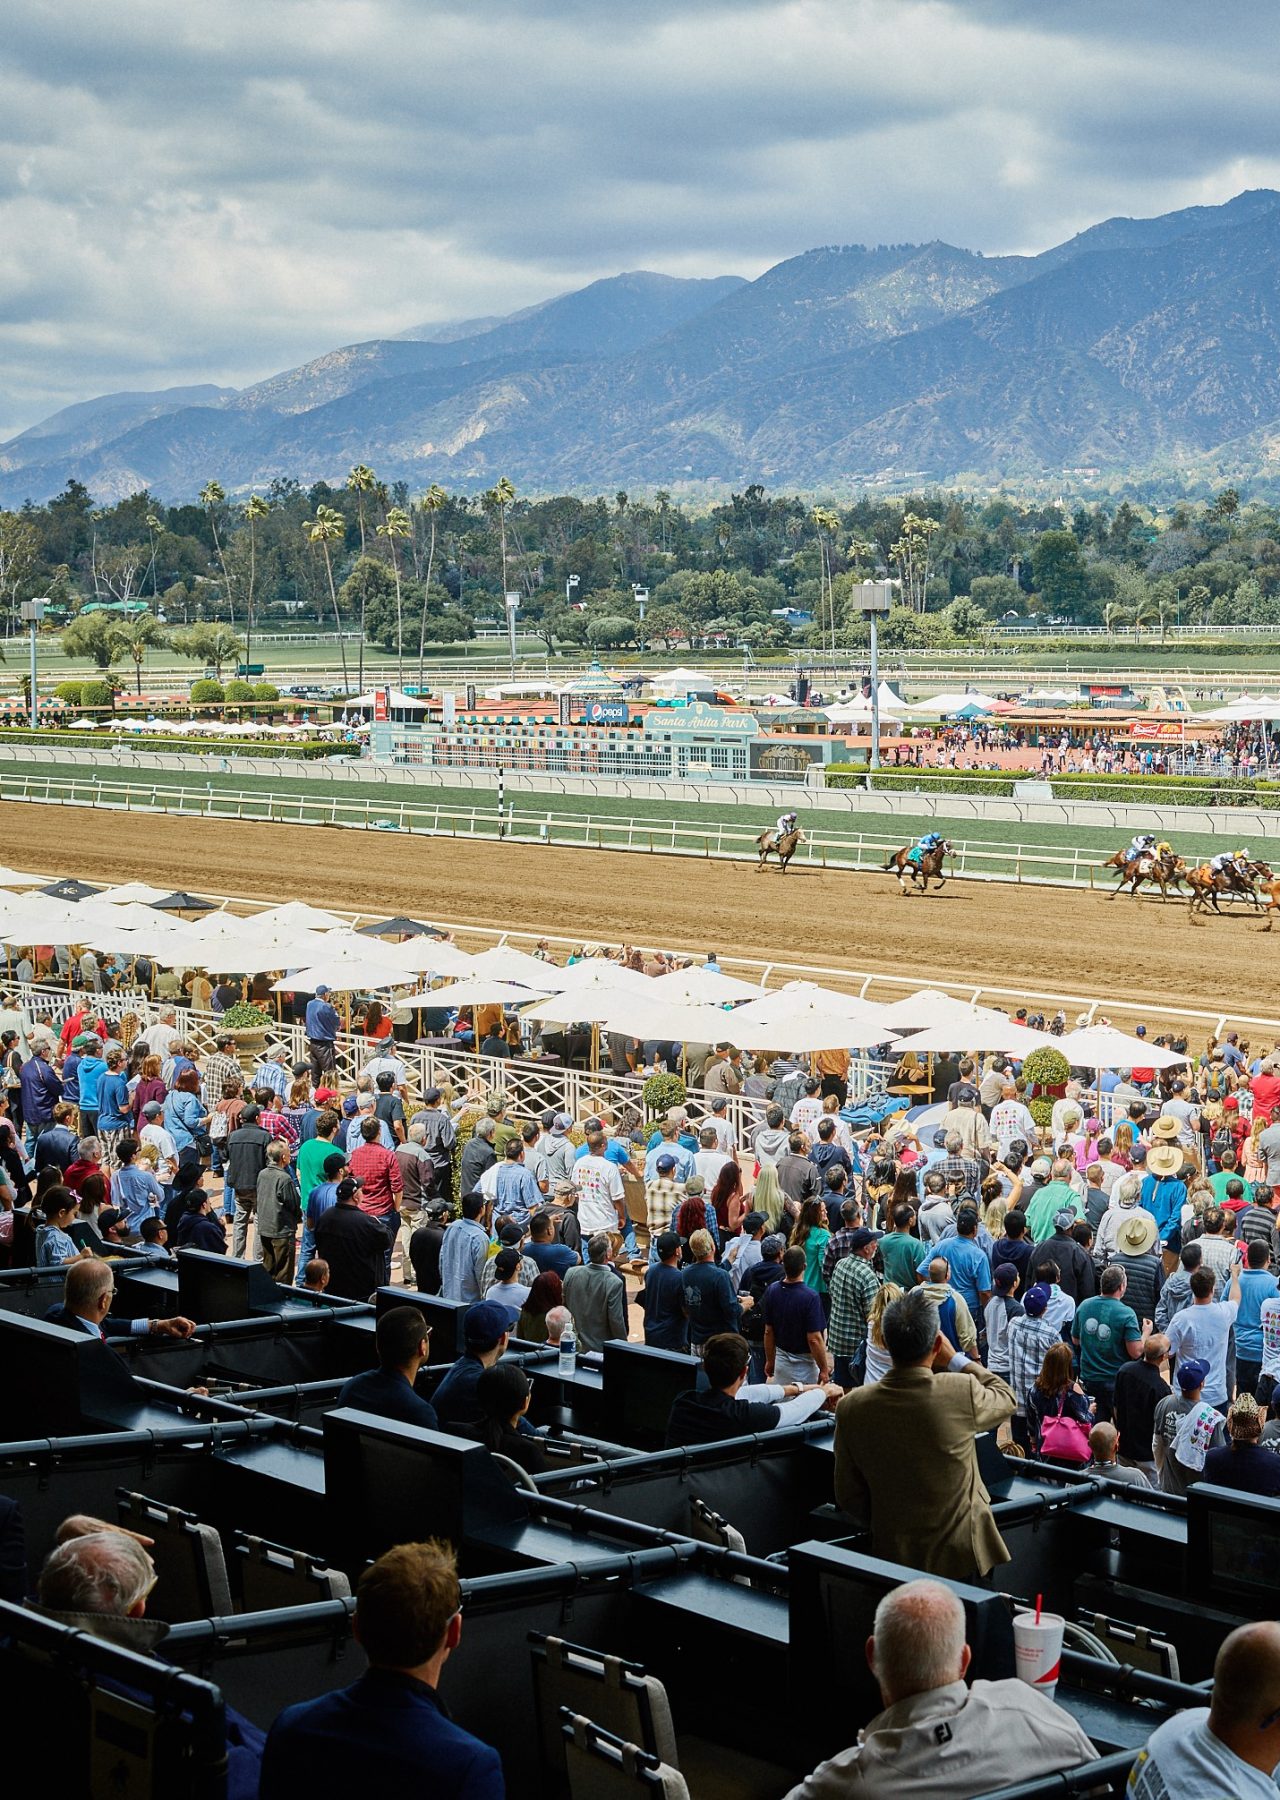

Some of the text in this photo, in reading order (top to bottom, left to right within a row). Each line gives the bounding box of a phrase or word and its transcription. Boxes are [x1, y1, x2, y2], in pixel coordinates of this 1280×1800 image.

[602, 707, 623, 720] pepsi
[652, 715, 749, 729] Santa Anita Park
